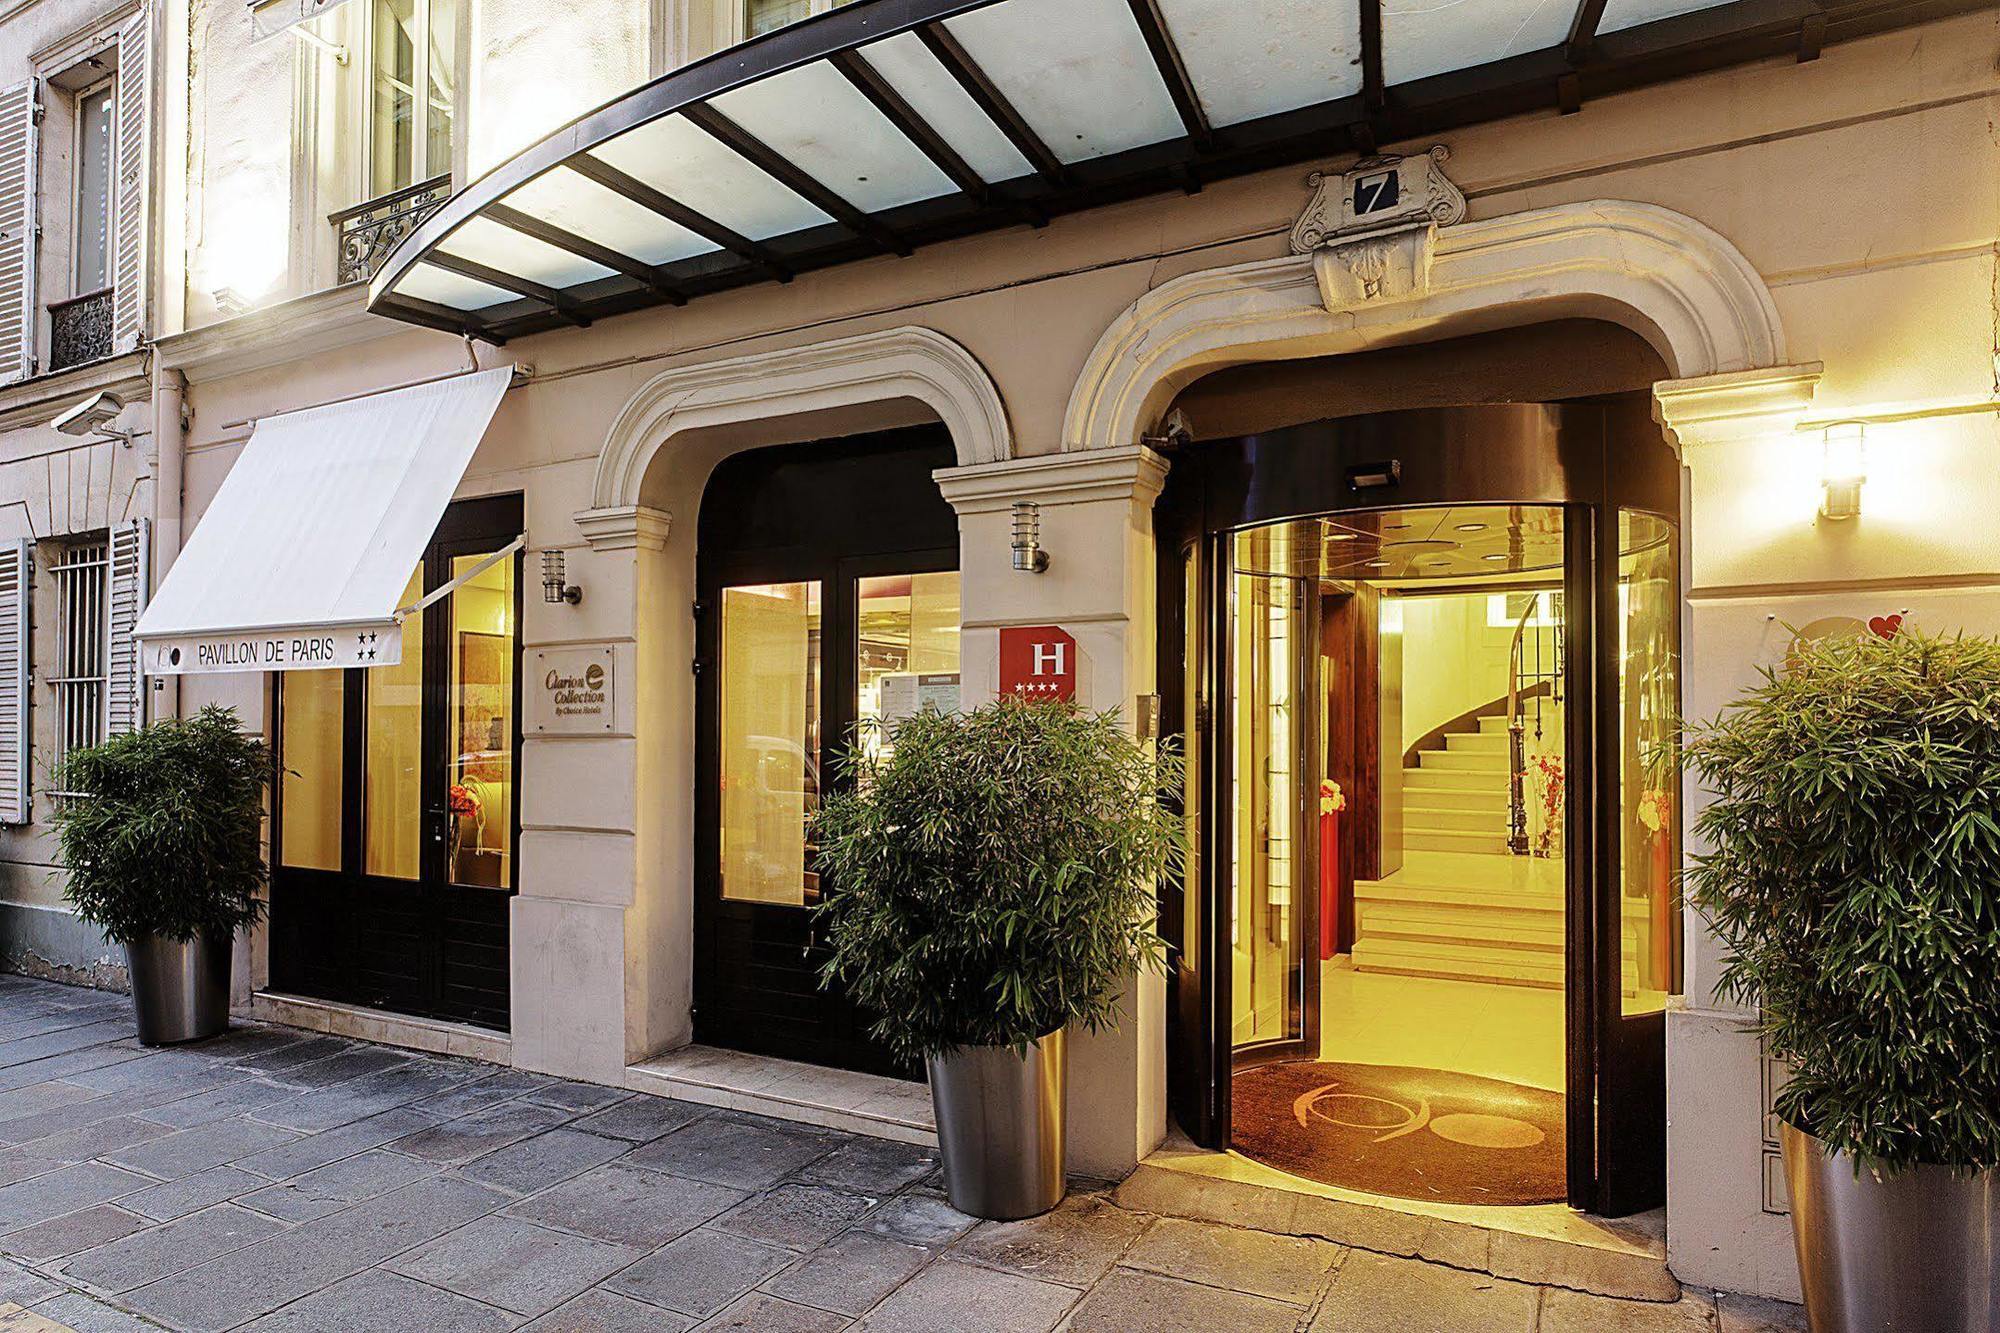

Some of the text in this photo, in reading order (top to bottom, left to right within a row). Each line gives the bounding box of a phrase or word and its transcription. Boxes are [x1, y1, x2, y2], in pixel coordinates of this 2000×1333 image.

[1361, 173, 1389, 214] 7
[199, 638, 334, 665] PAVILLON DE PARIS
[1031, 642, 1067, 676] H
[545, 669, 585, 690] Clarion
[554, 690, 605, 704] Collection
